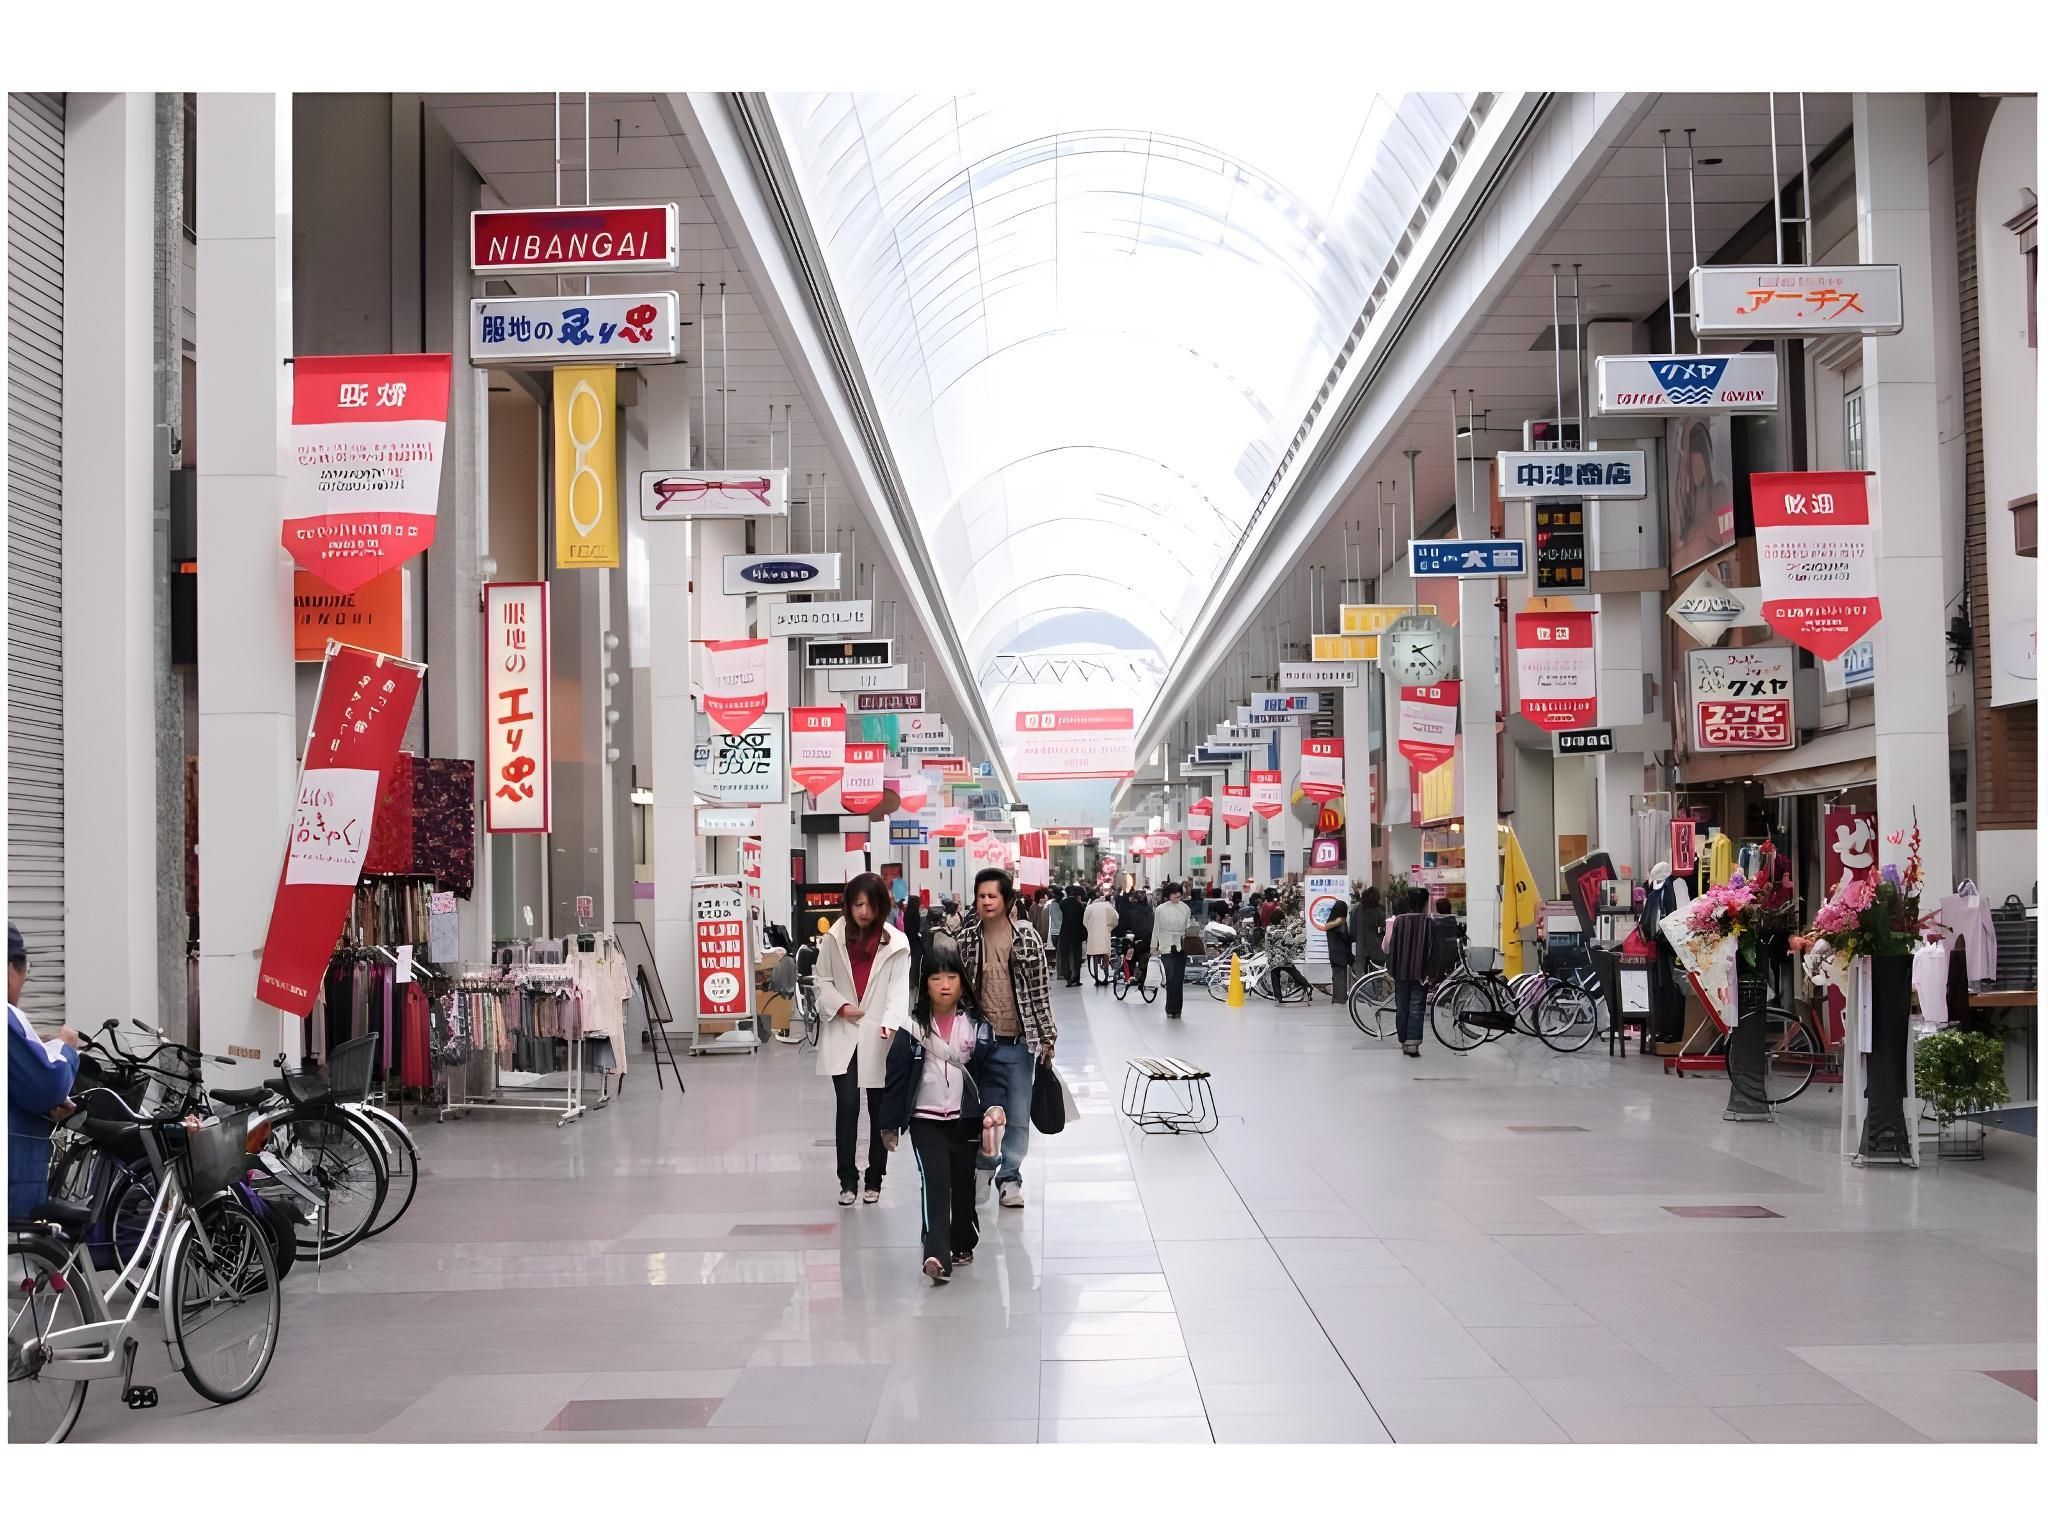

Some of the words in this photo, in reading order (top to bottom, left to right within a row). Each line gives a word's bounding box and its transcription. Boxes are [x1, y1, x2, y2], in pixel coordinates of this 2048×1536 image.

[488, 231, 648, 262] NIBANGAI
[1727, 678, 1789, 697] クメヤ
